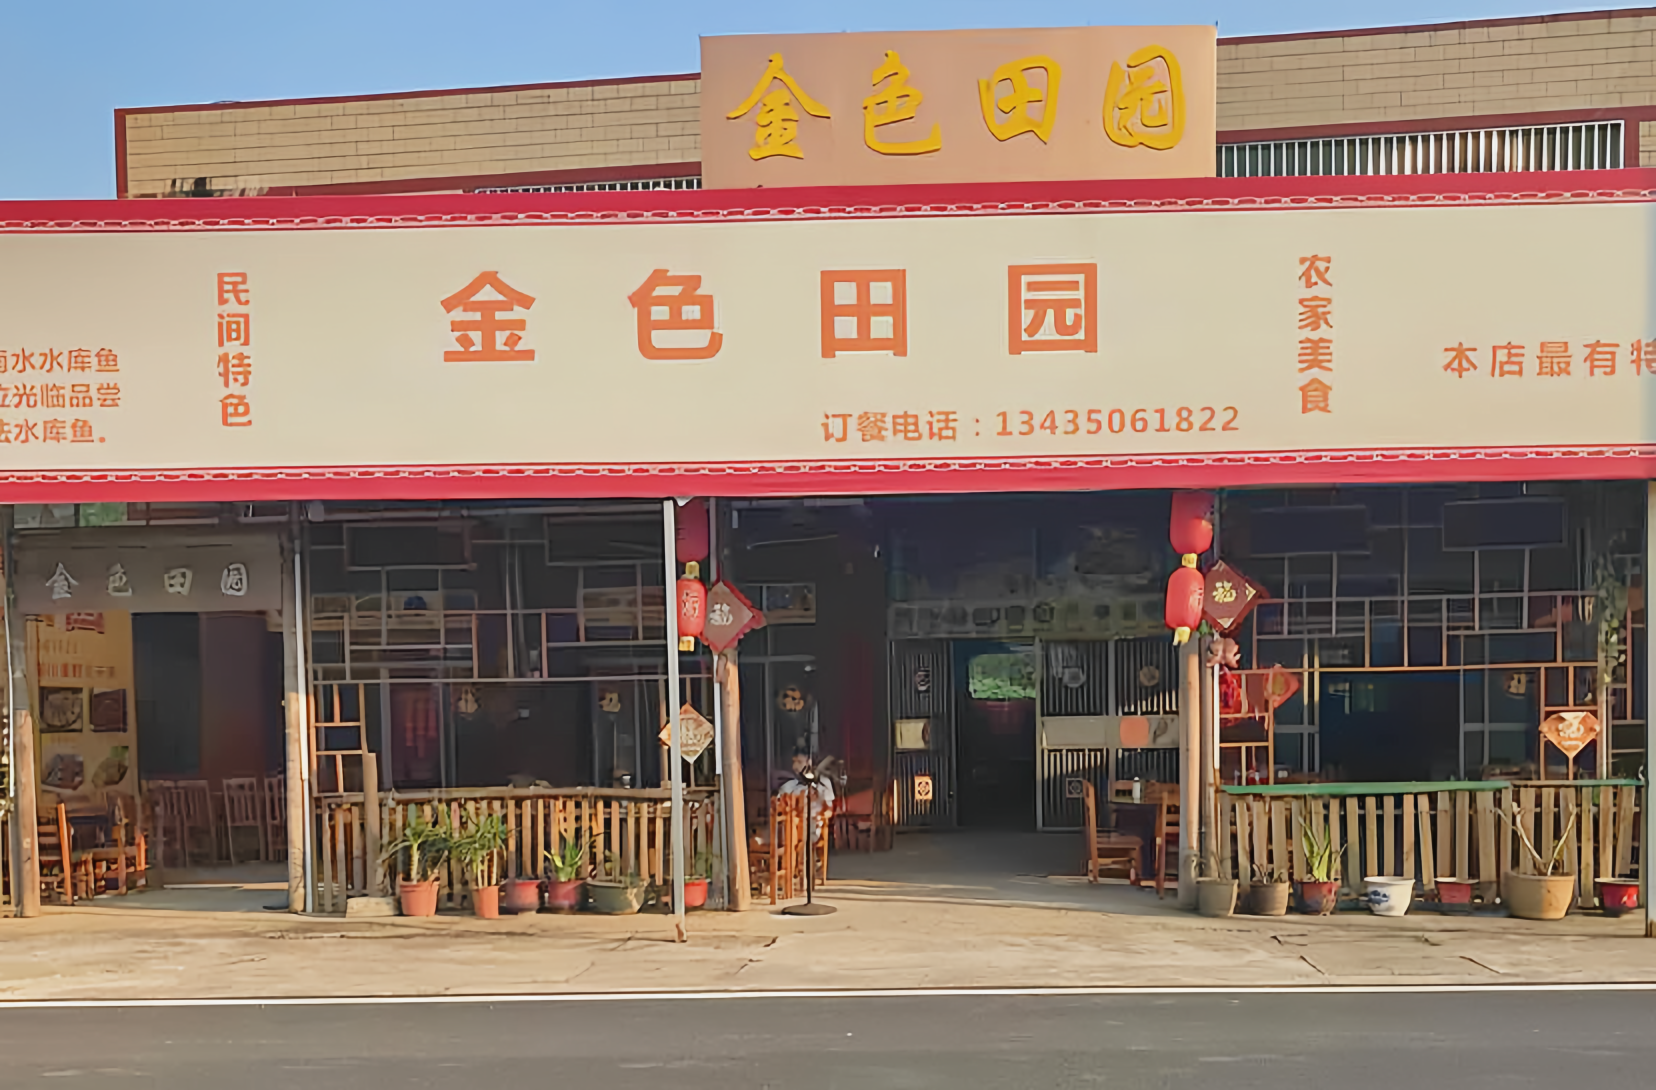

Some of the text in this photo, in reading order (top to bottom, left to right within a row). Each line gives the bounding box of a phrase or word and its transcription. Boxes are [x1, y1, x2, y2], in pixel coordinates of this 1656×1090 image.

[726, 45, 1187, 161] 金色田园
[216, 272, 253, 427] 民间特色
[440, 257, 1098, 363] 金色田园
[1297, 254, 1333, 415] 农家美食
